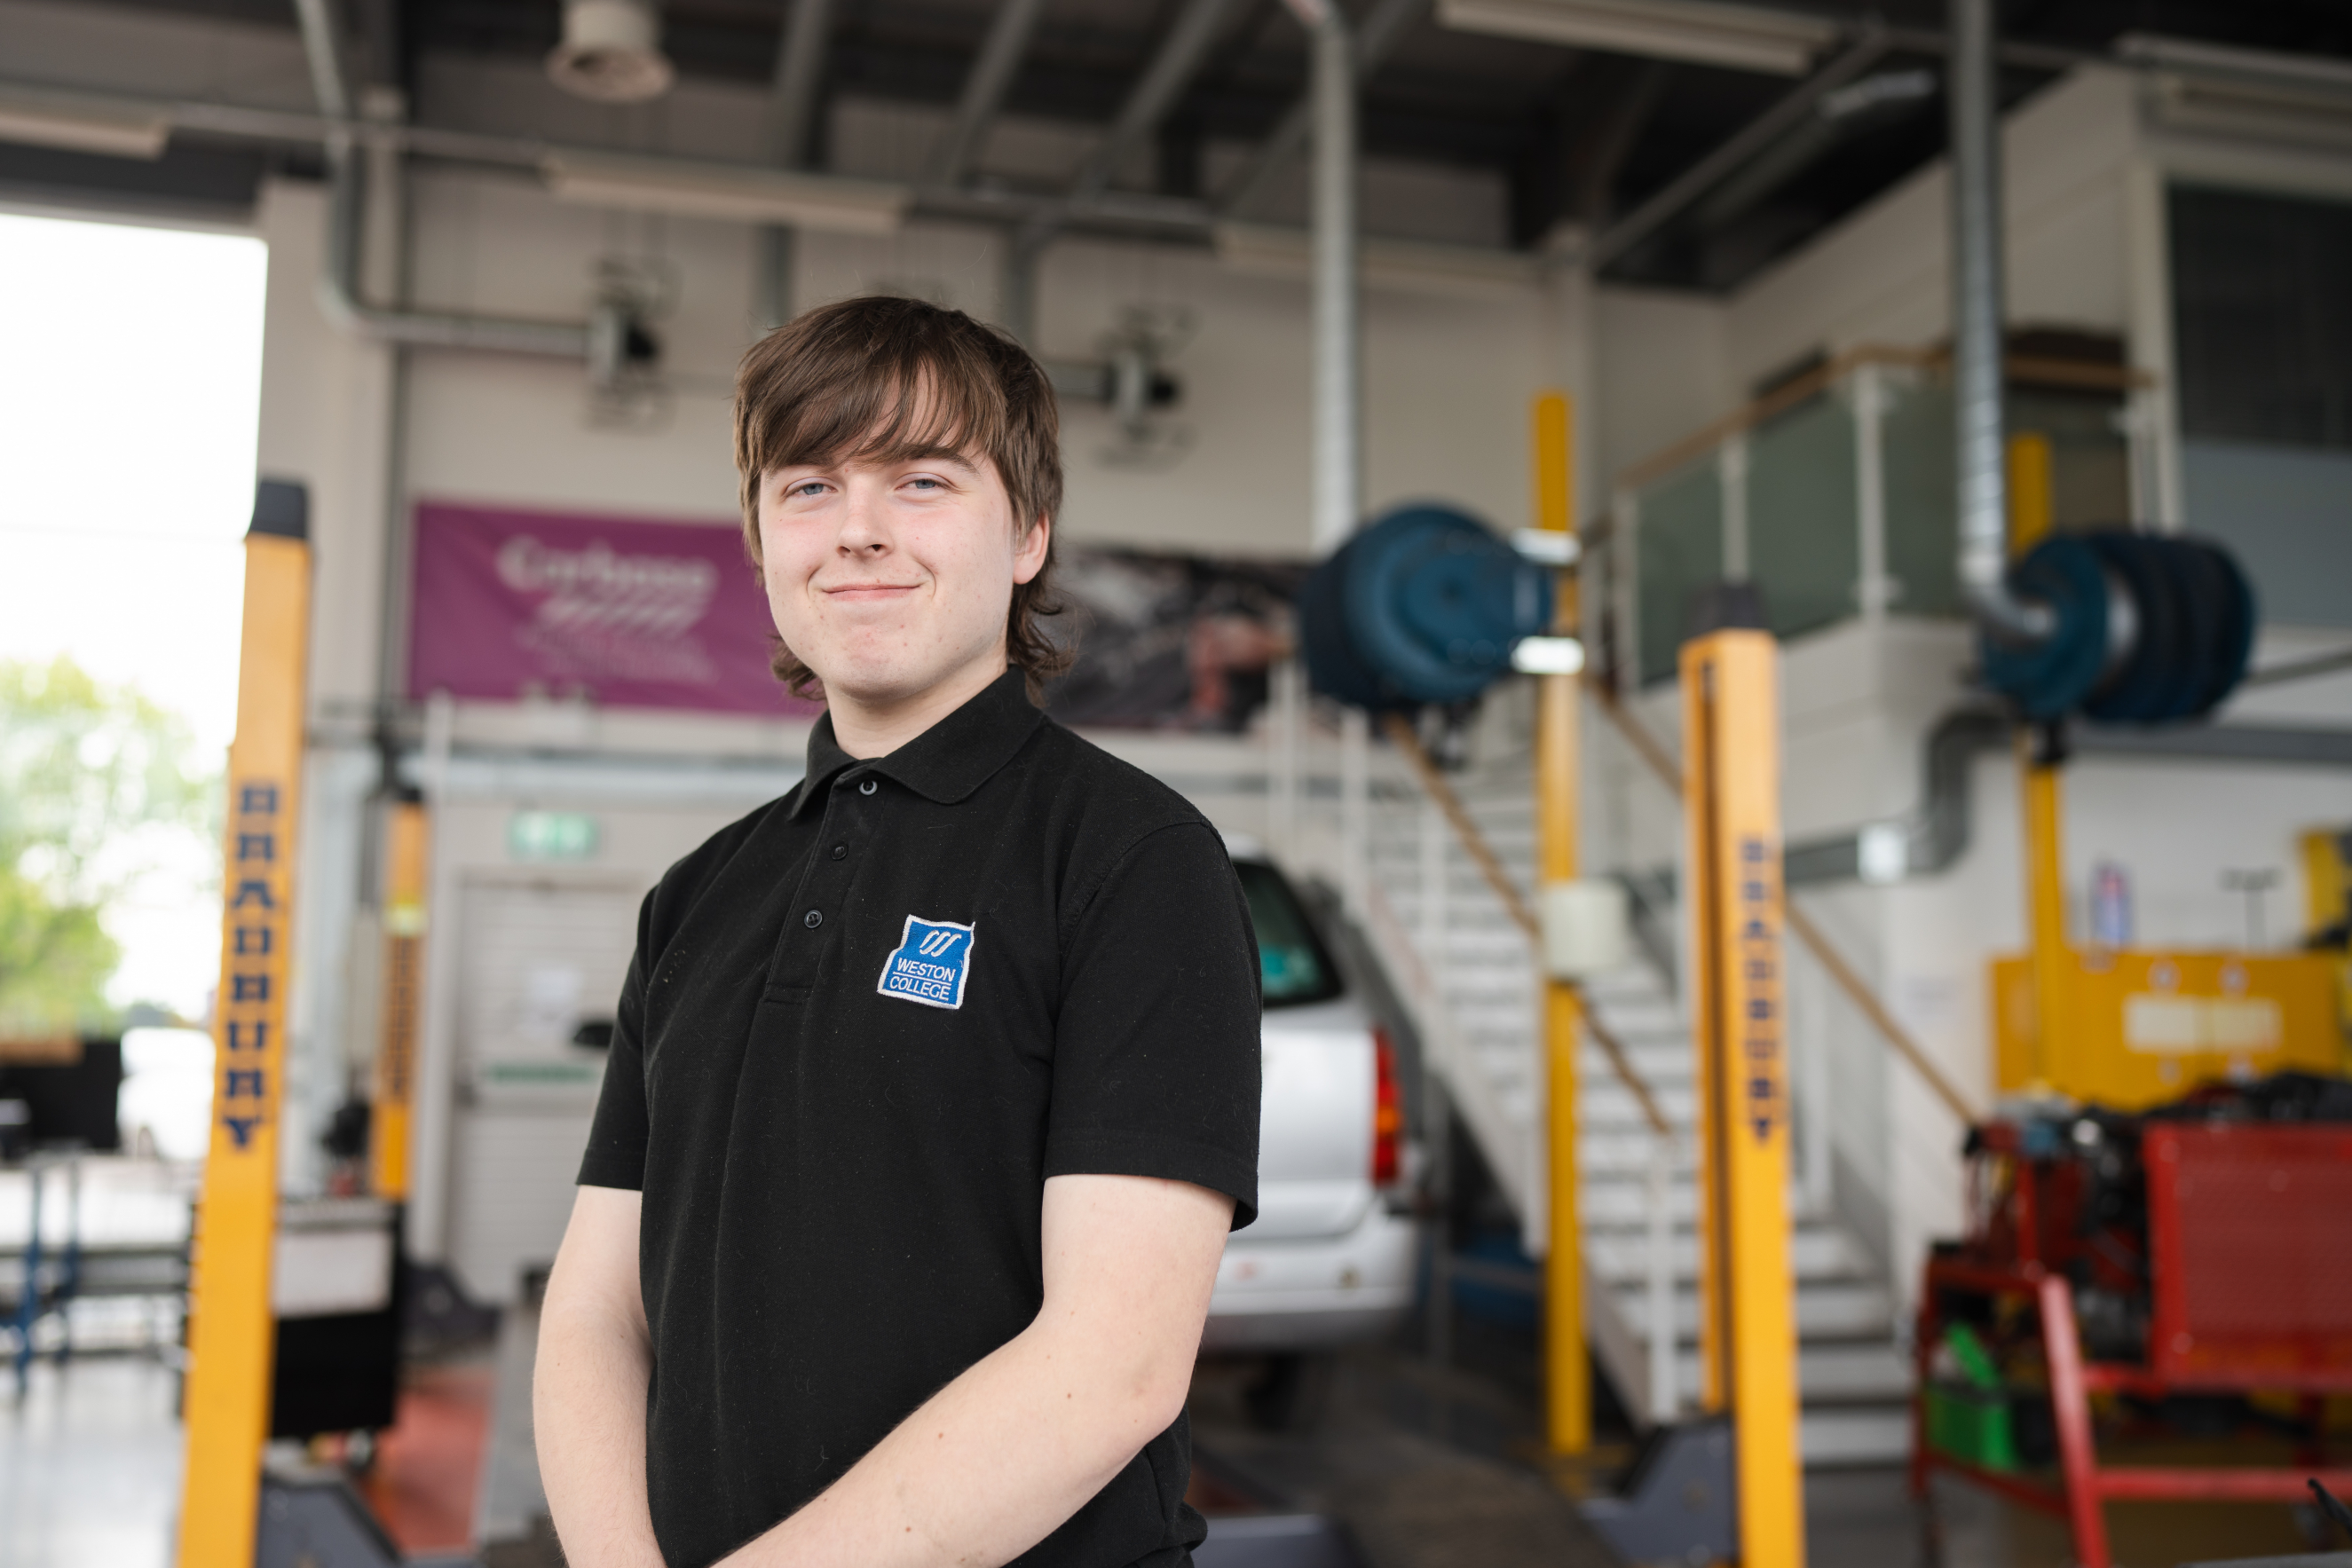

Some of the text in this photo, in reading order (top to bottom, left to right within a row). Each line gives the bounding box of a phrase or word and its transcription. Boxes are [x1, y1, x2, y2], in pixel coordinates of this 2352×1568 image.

[224, 784, 280, 1149] BRADBURY
[897, 957, 956, 981] WESTON
[889, 976, 951, 1001] COLLEGE
